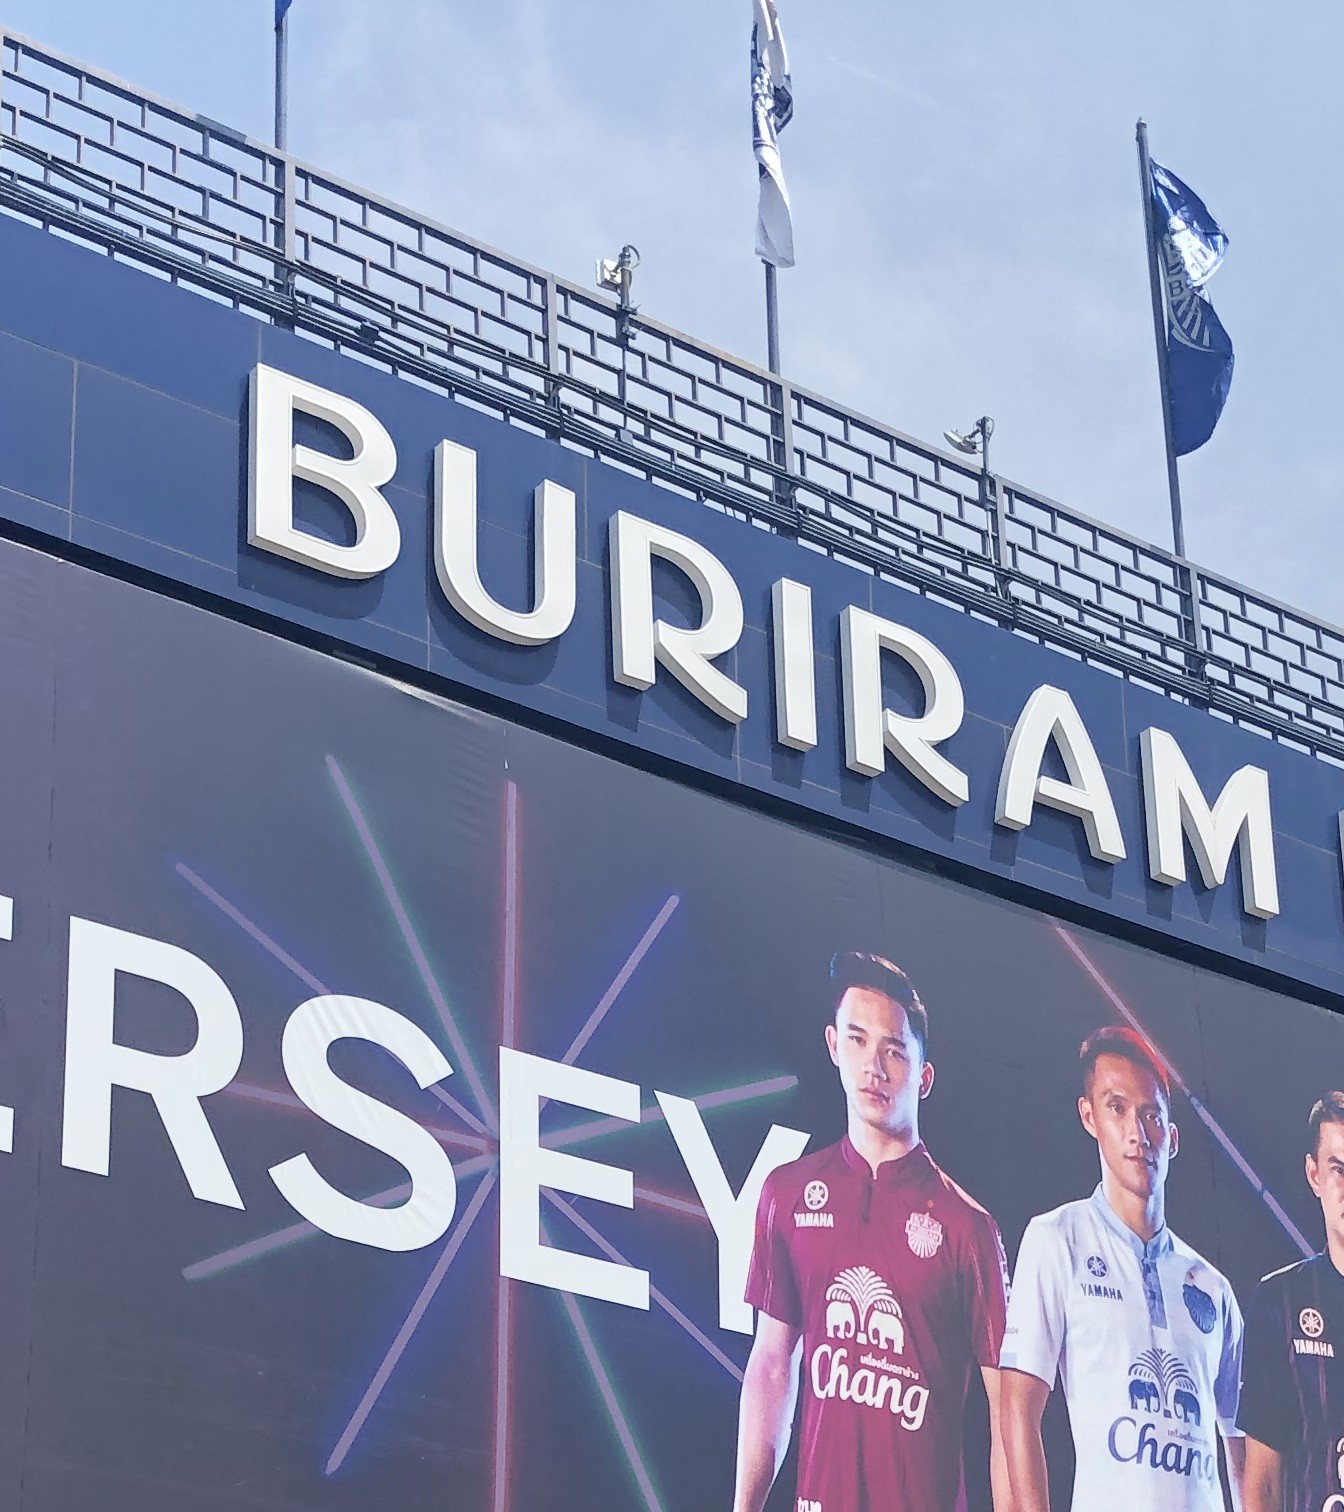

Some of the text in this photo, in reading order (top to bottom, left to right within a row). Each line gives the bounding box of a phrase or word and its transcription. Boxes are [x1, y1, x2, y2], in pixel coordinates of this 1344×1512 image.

[247, 361, 1281, 920] BURIRAM
[794, 1213, 834, 1228] YAMAHA
[1081, 1283, 1123, 1301] YAMAHA
[1293, 1339, 1334, 1357] YAMAHA
[811, 1344, 929, 1431] Chang
